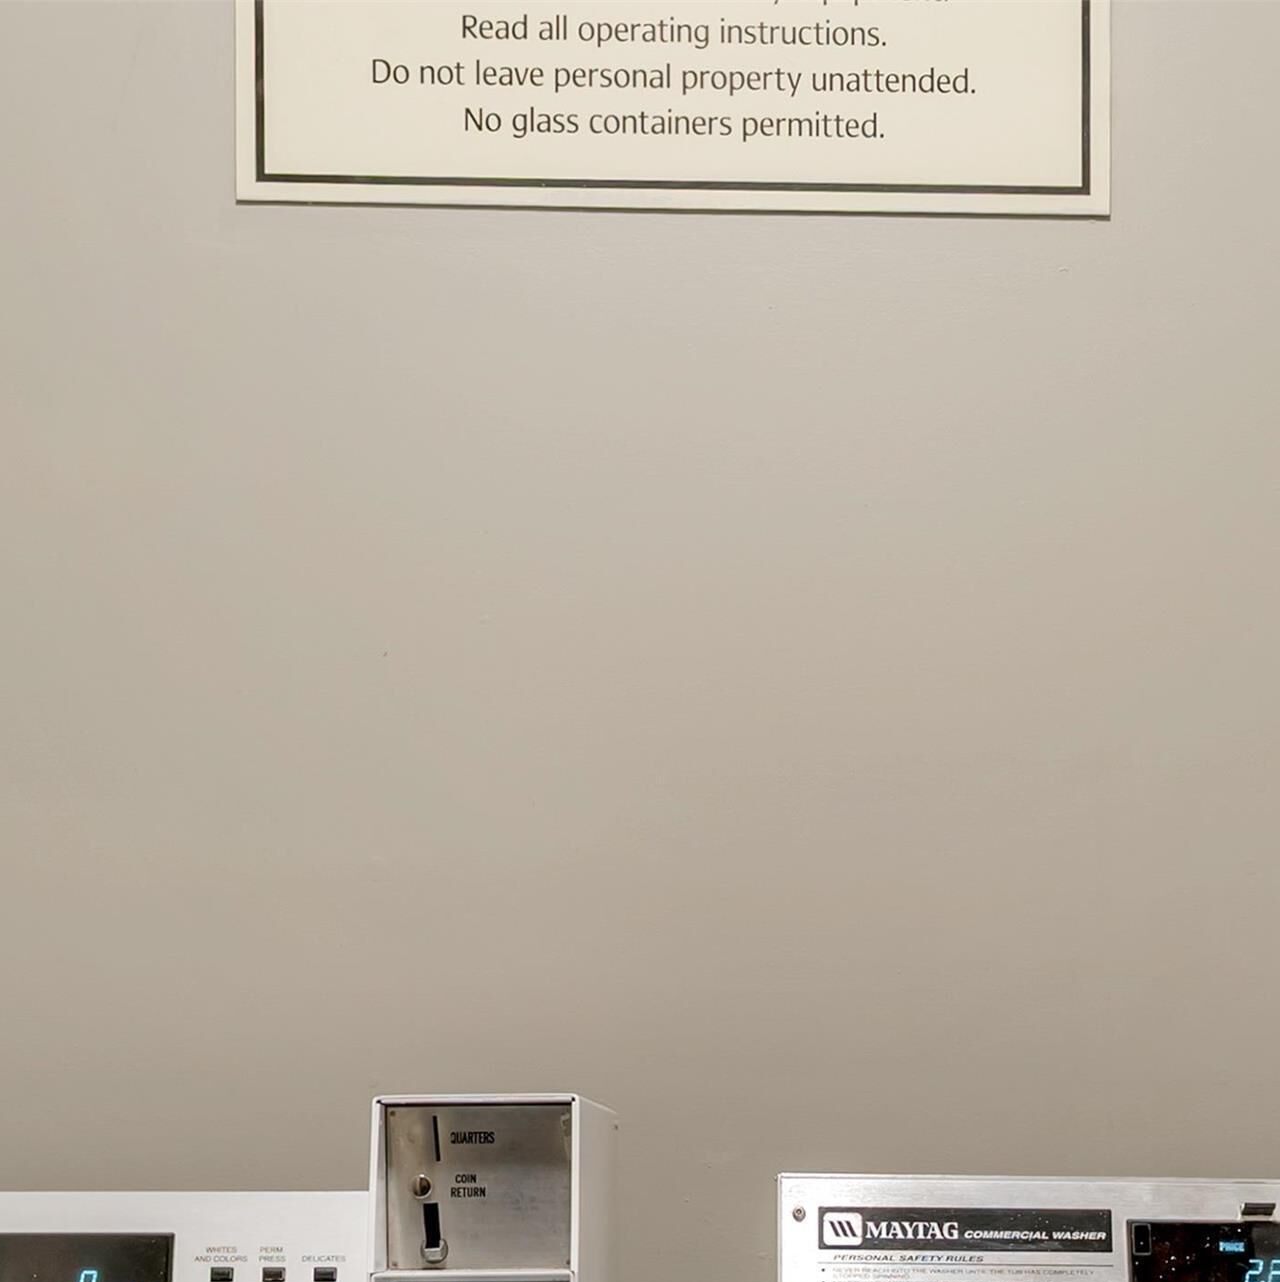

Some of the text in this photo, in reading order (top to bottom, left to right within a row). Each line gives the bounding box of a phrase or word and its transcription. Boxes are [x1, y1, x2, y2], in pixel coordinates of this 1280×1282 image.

[462, 14, 886, 49] Read all operating instructions.
[373, 59, 975, 97] Do not leave personal property unattended.
[465, 107, 884, 142] No glass containers permitted.
[450, 1132, 495, 1144] QUARTERS
[456, 1174, 476, 1183] COIN
[450, 1187, 486, 1198] RETURN
[866, 1222, 1106, 1241] MAYTAG COMMERCIAL WASHER
[206, 1246, 237, 1254] WHITES
[260, 1246, 283, 1254] PERM
[1220, 1242, 1245, 1252] PRICE
